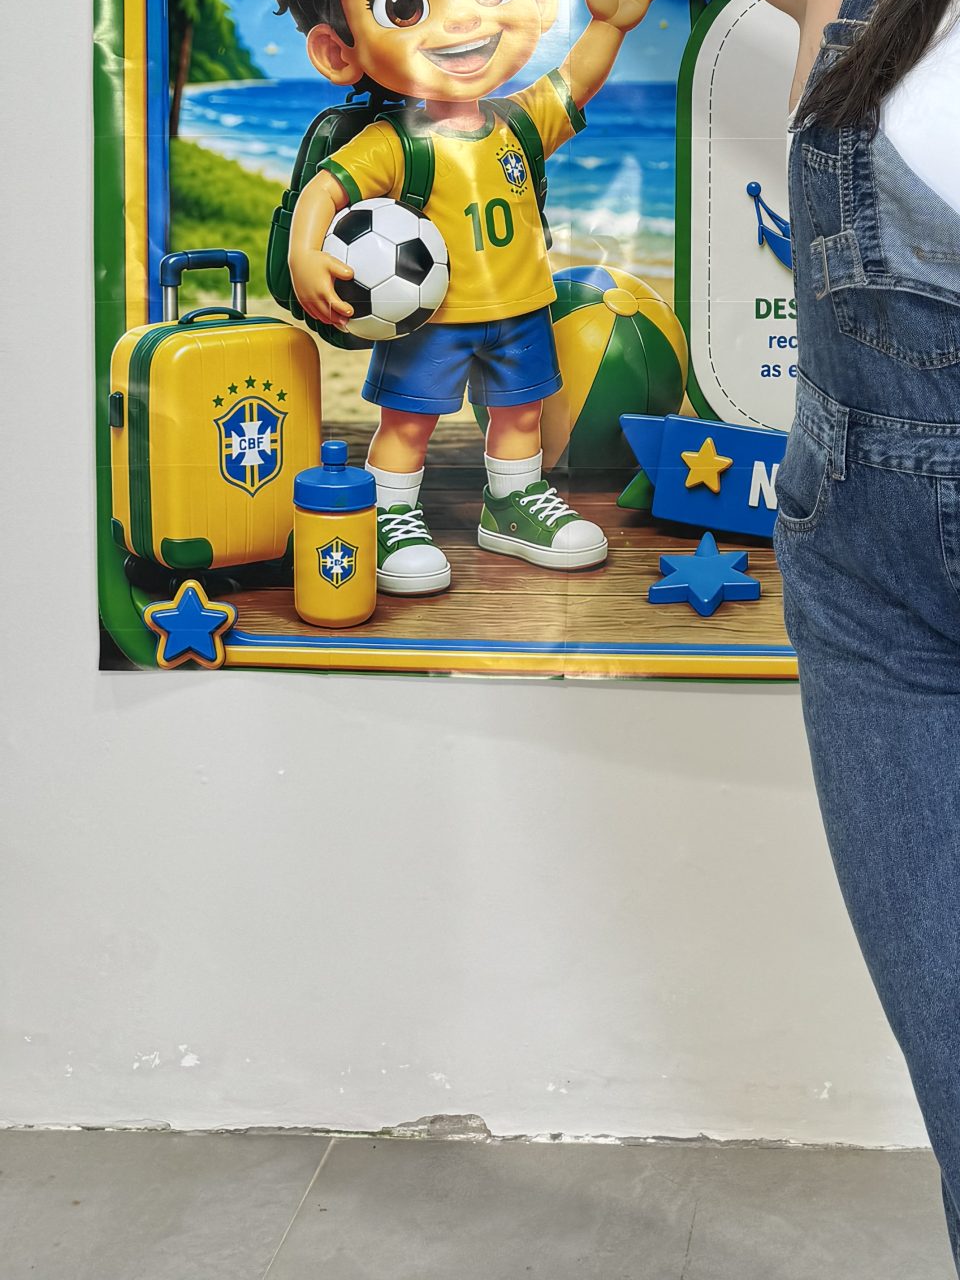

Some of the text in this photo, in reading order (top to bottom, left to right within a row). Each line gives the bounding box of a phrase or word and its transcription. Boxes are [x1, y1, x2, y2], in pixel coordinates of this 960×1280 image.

[463, 197, 515, 252] 10
[760, 364, 782, 378] as
[239, 436, 264, 451] CBF
